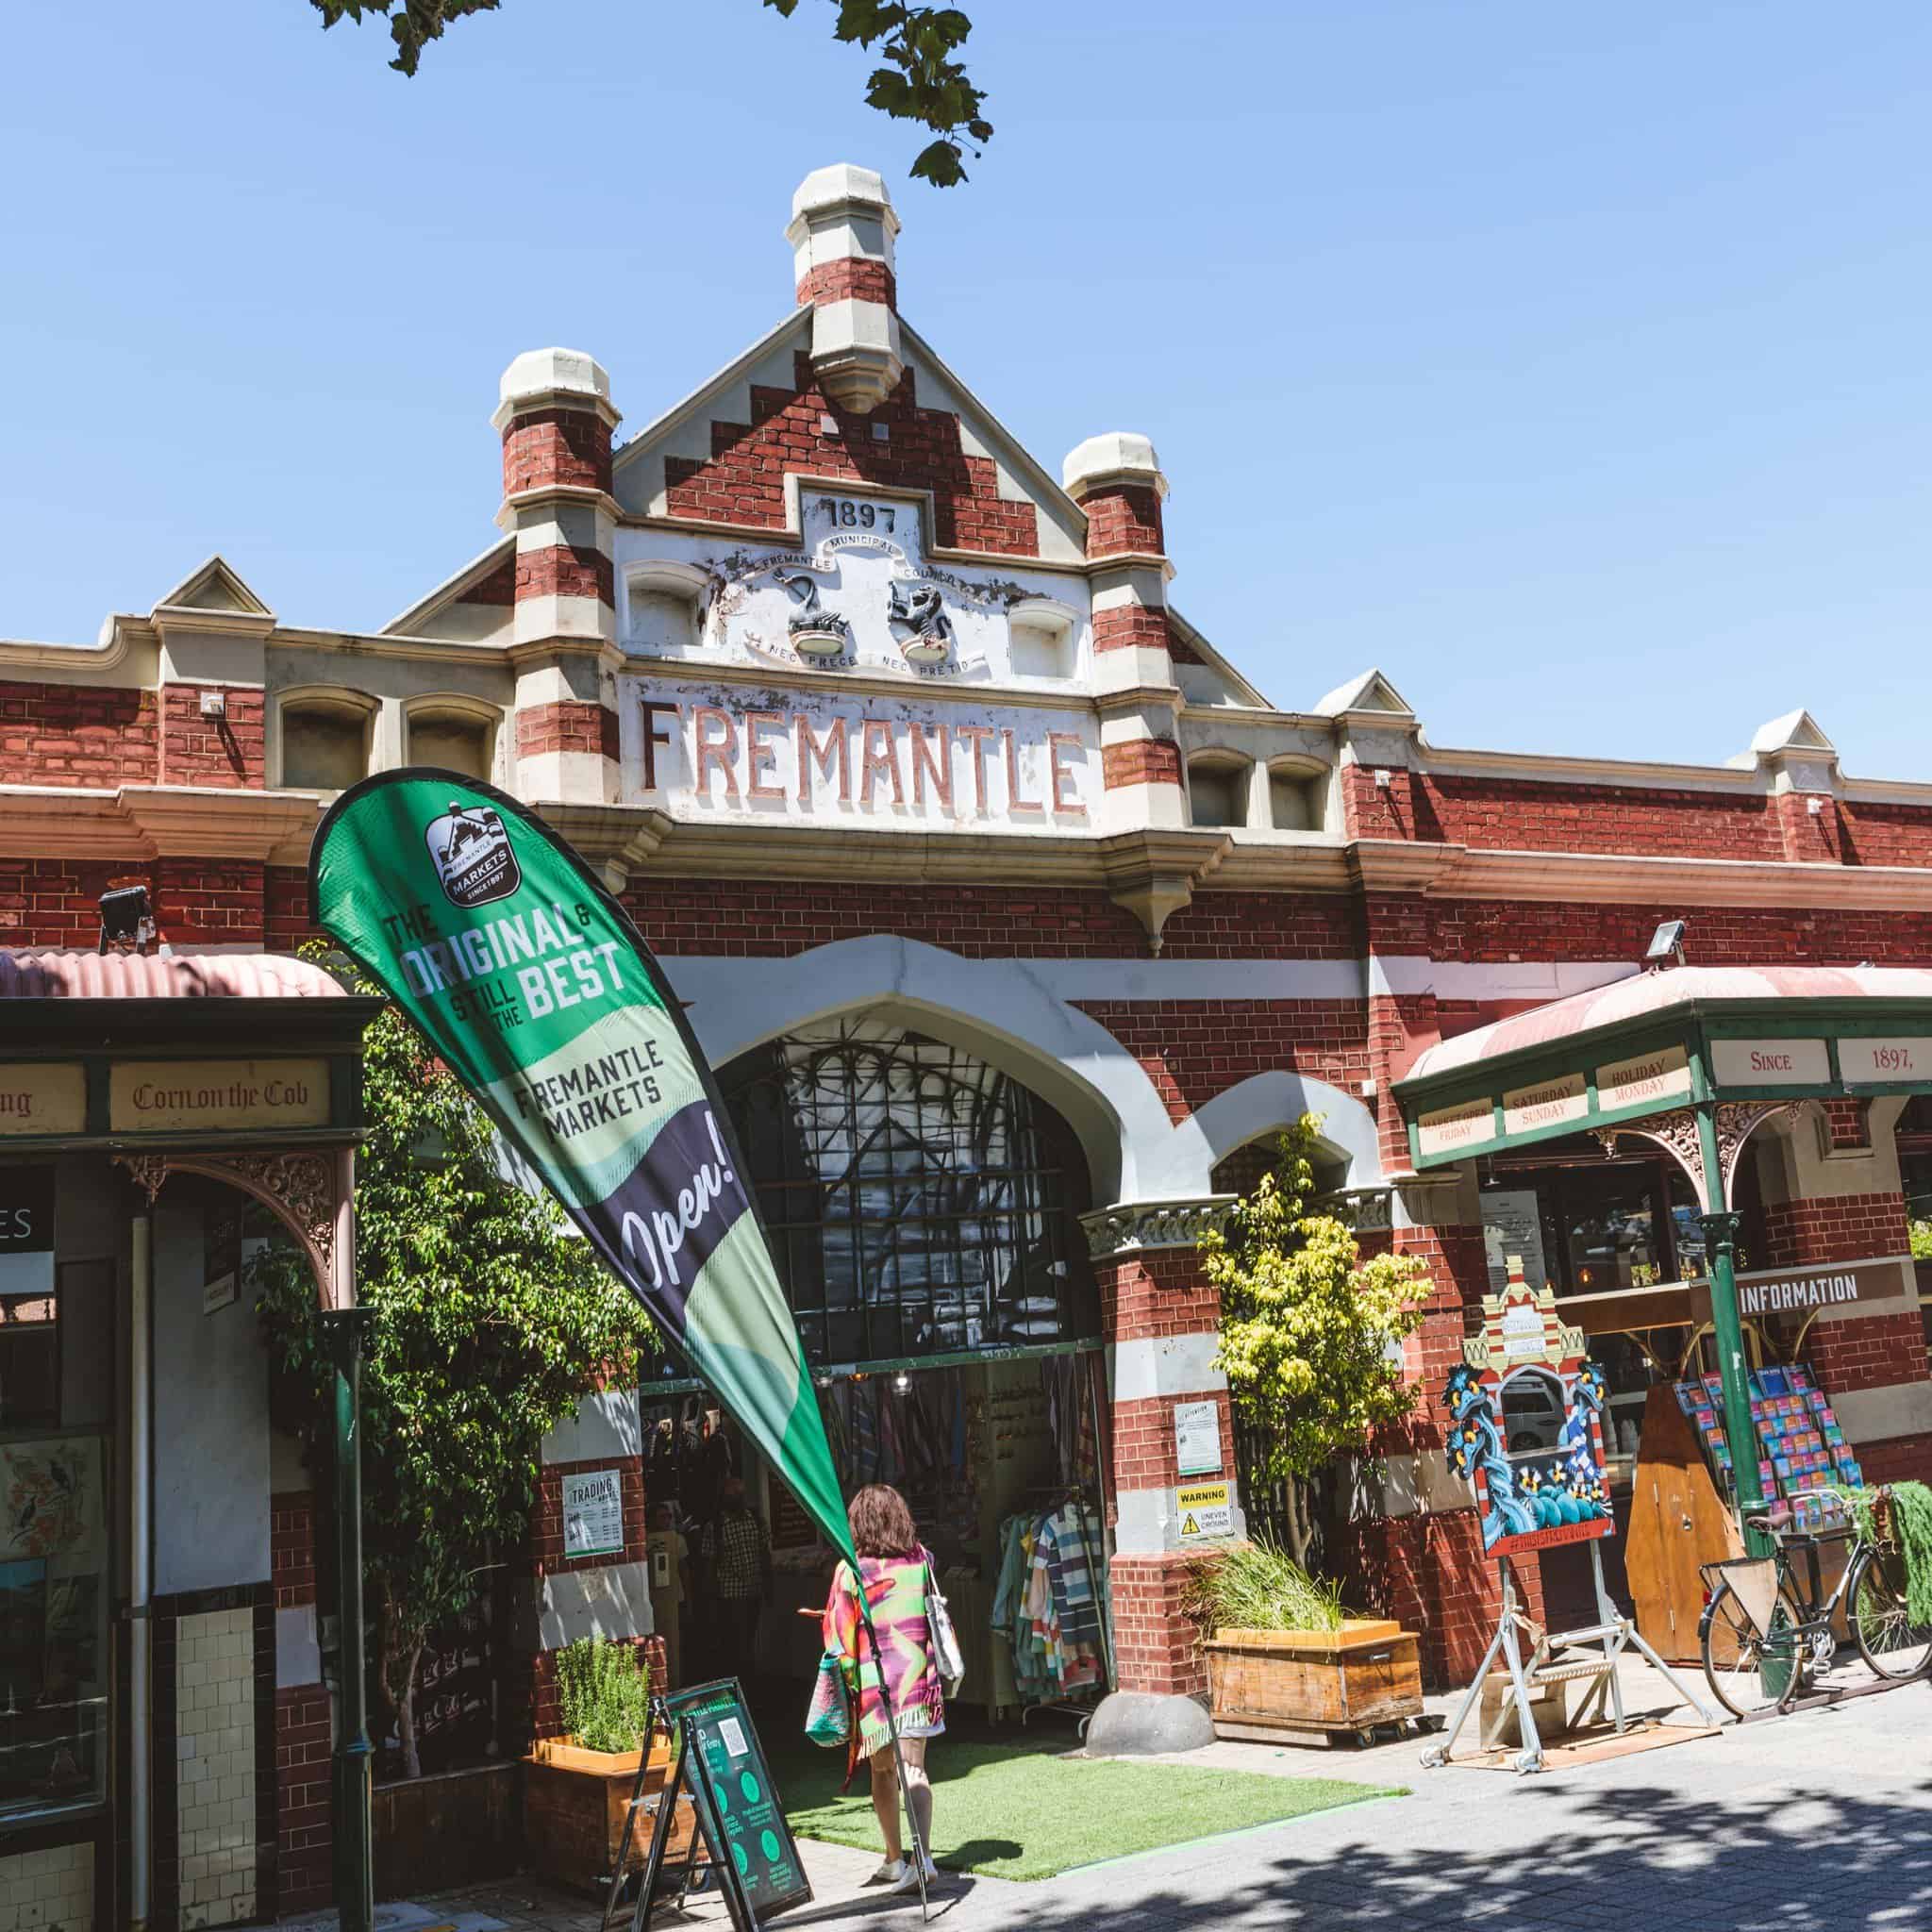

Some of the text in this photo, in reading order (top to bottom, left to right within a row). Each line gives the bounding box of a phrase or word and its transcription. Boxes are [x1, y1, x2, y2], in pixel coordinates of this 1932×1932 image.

[826, 499, 896, 534] 1897
[830, 535, 895, 555] MUNICIPAL
[761, 553, 832, 570] FREMANTLE
[769, 644, 969, 676] NEC PRECE NEC PRETIO
[641, 701, 1088, 816] FREMANTLE
[453, 849, 507, 894] MARKETS
[383, 904, 438, 944] THE
[400, 903, 591, 998] ORIGINAL &
[516, 941, 625, 1020] BEST
[449, 979, 515, 1022] STILL
[491, 1006, 525, 1030] THE
[513, 1039, 664, 1119] FREMANTLE
[1611, 1058, 1666, 1084] HOLIDAY
[132, 1081, 308, 1110] Corn on the Cob
[1512, 1083, 1574, 1109] SATURDAY
[1614, 1076, 1667, 1102] MONDAY
[542, 1075, 662, 1144] MARKETS
[1522, 1104, 1567, 1125] SUNDAY
[1440, 1124, 1472, 1141] FRIDAY
[621, 1110, 733, 1292] Open!
[1740, 1274, 1858, 1314] INFORMATION
[573, 1477, 612, 1504] TRADING
[1180, 1490, 1225, 1503] WARNING
